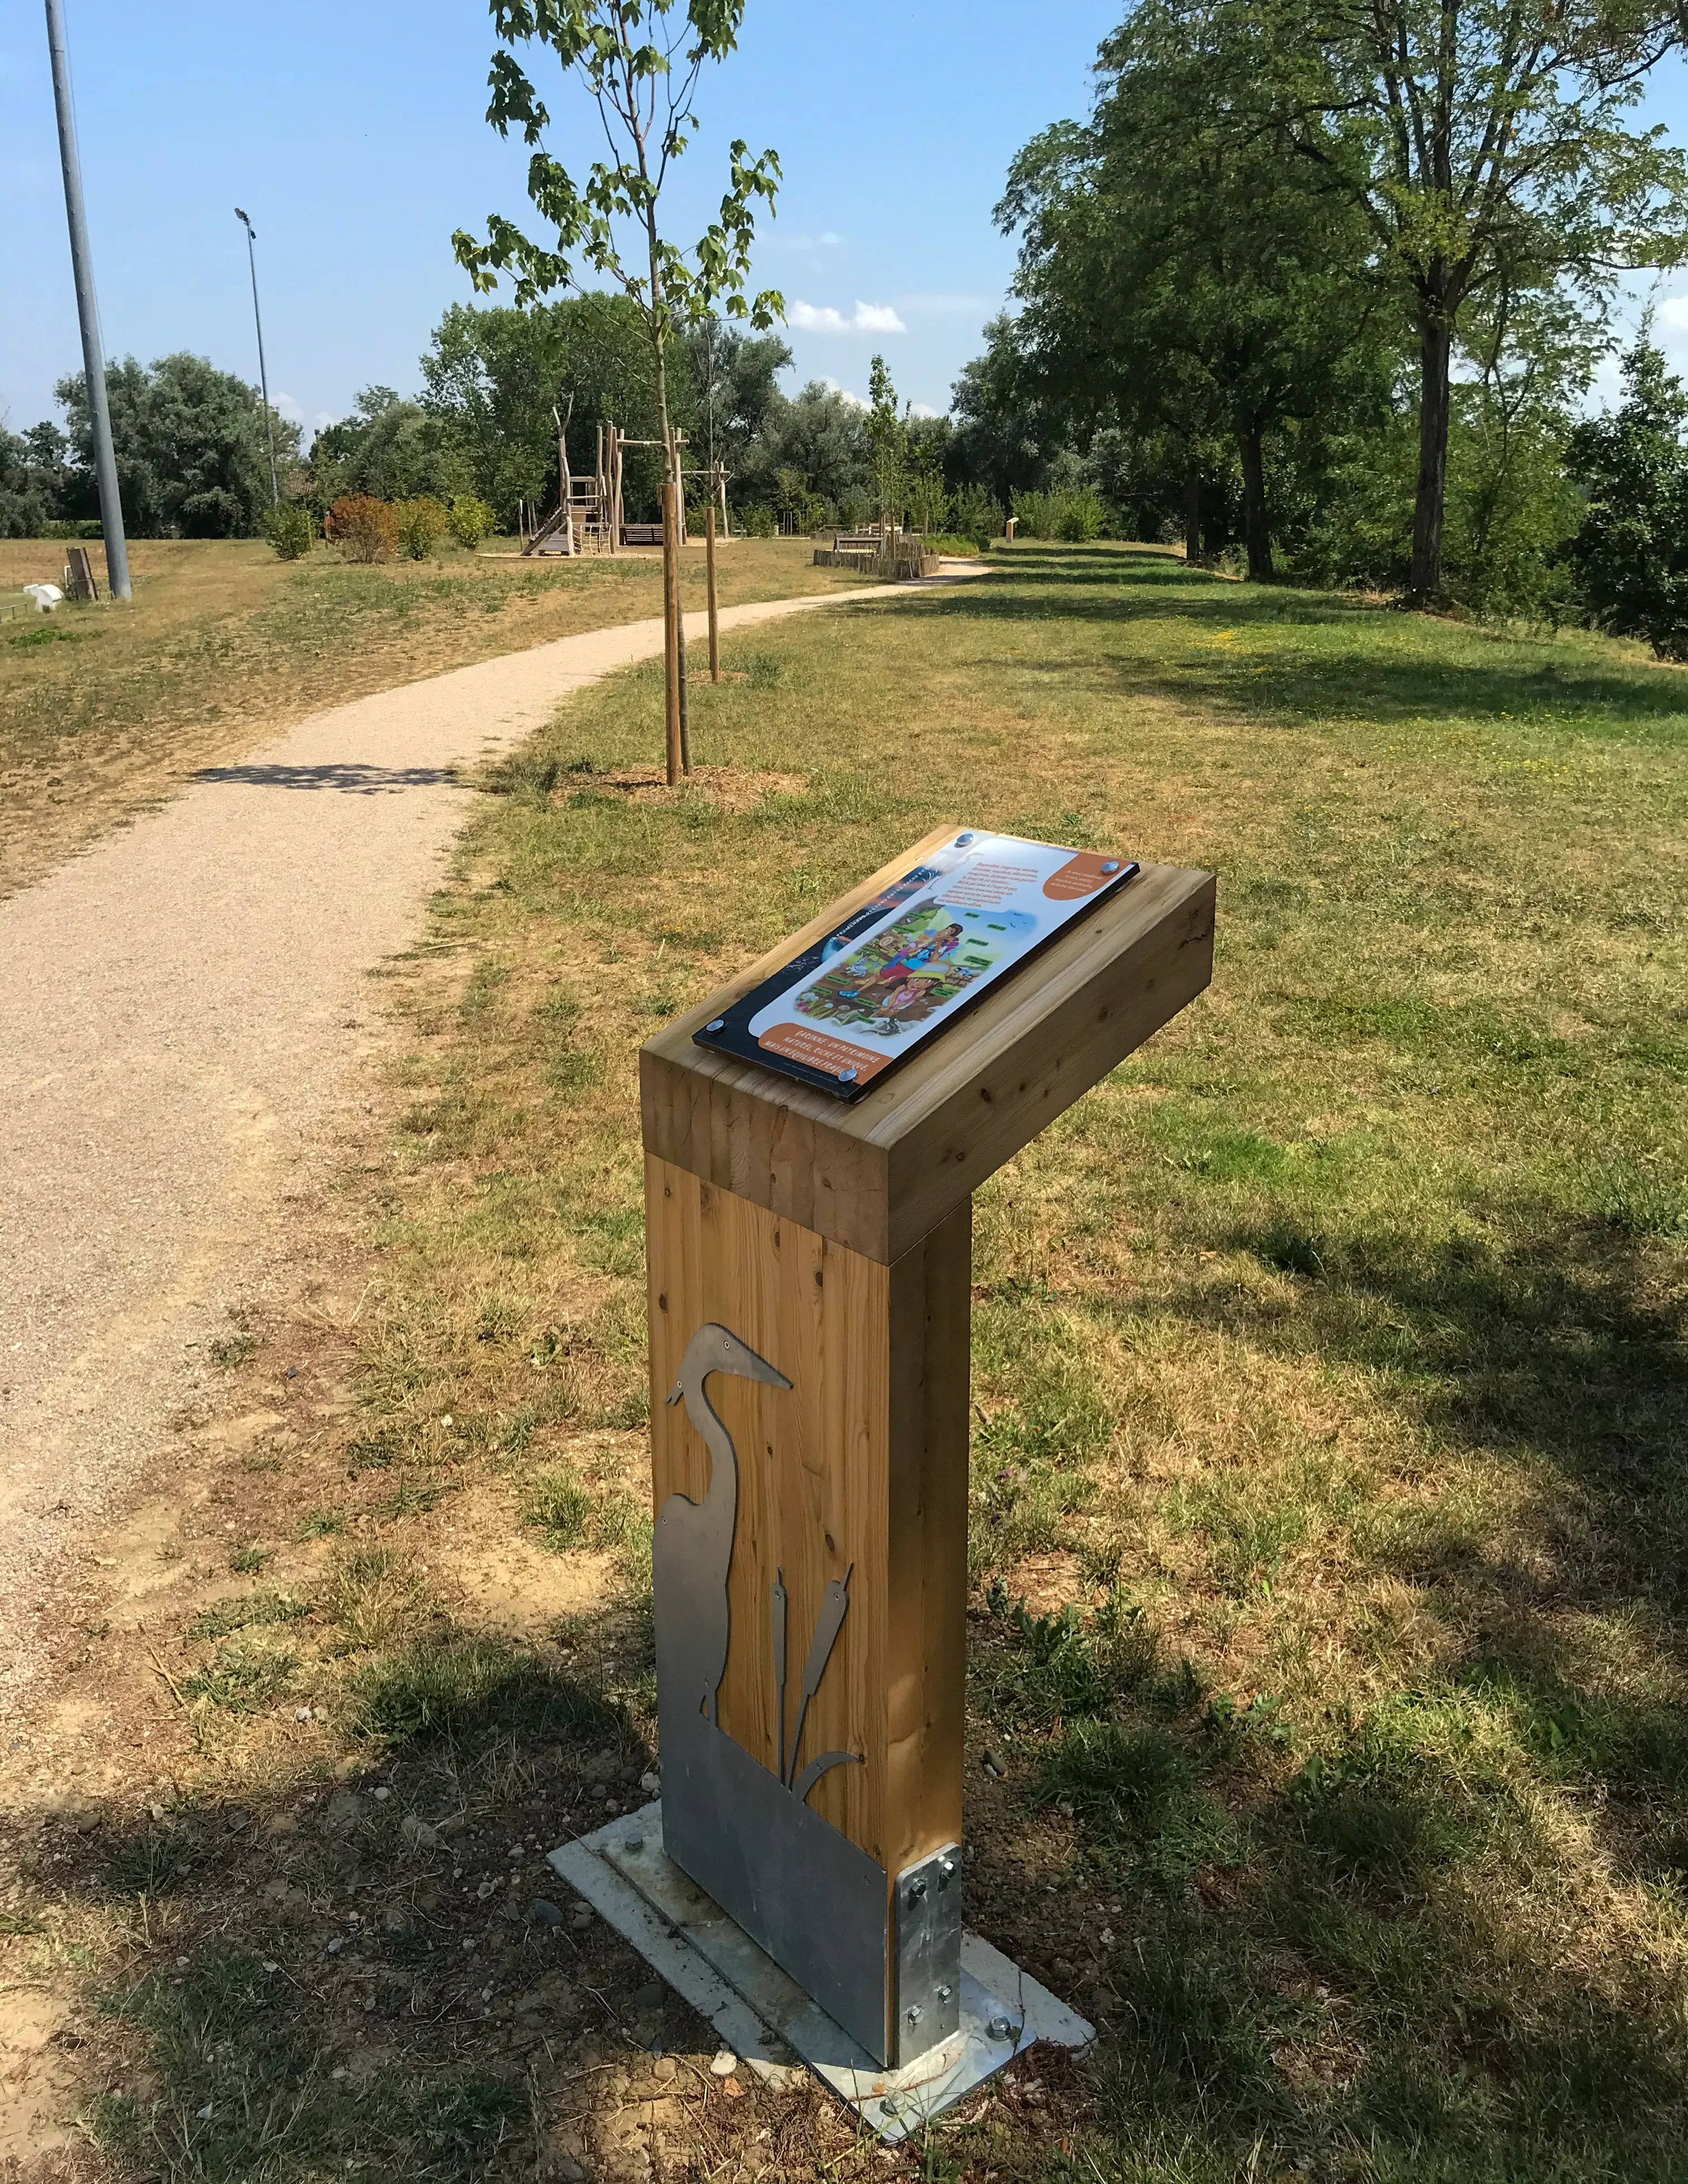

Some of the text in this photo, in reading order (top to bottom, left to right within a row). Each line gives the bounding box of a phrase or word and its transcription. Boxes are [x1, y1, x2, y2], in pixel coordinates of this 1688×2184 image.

[763, 1040, 782, 1050] MAIS
[820, 1061, 846, 1073] FRAGIL
[794, 1030, 828, 1044] GARONNE
[838, 1045, 881, 1063] PATRIMOINE
[812, 1047, 835, 1058] RICHE
